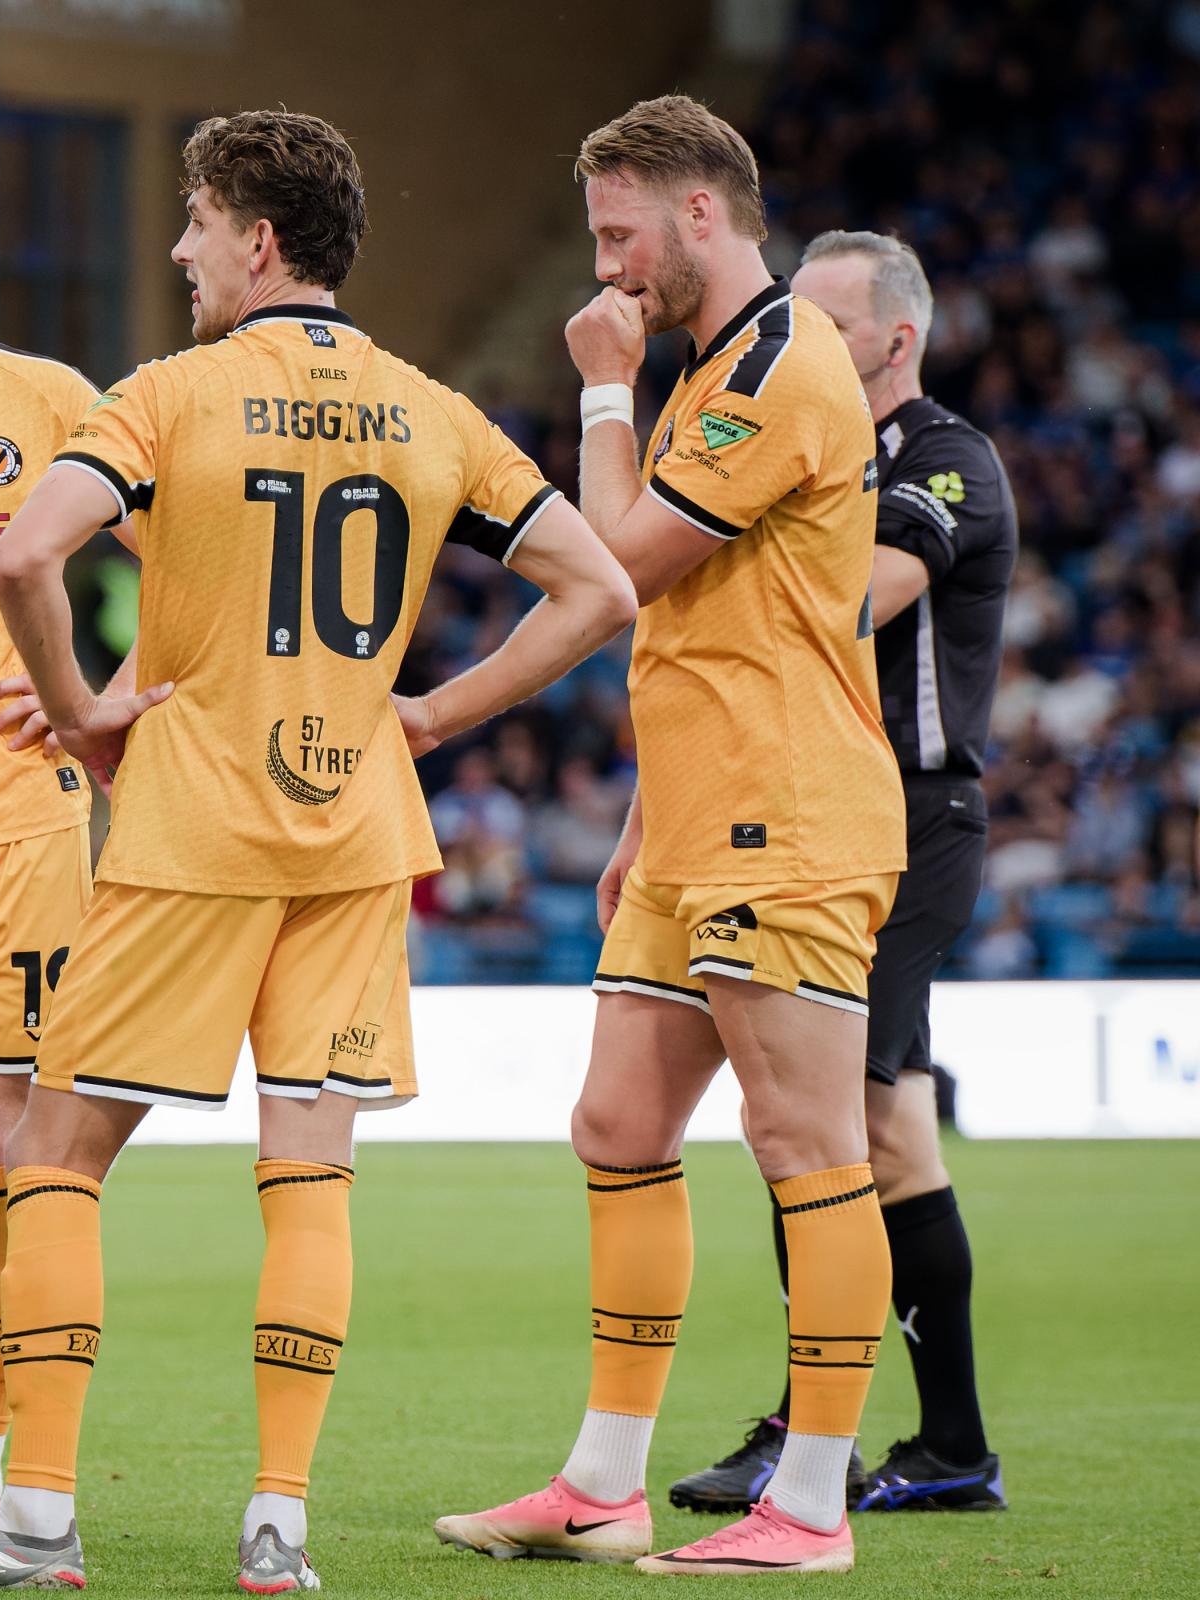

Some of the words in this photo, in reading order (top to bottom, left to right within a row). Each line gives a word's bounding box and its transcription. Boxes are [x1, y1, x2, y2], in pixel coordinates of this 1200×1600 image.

[311, 368, 347, 381] EXILES
[243, 397, 412, 444] BIGGINS
[705, 419, 739, 438] WEDGE
[715, 467, 730, 480] LTD
[245, 468, 410, 660] 10
[275, 643, 288, 652] EFL
[356, 646, 369, 654] EFL
[302, 715, 323, 742] 57
[255, 1334, 334, 1366] EXILES
